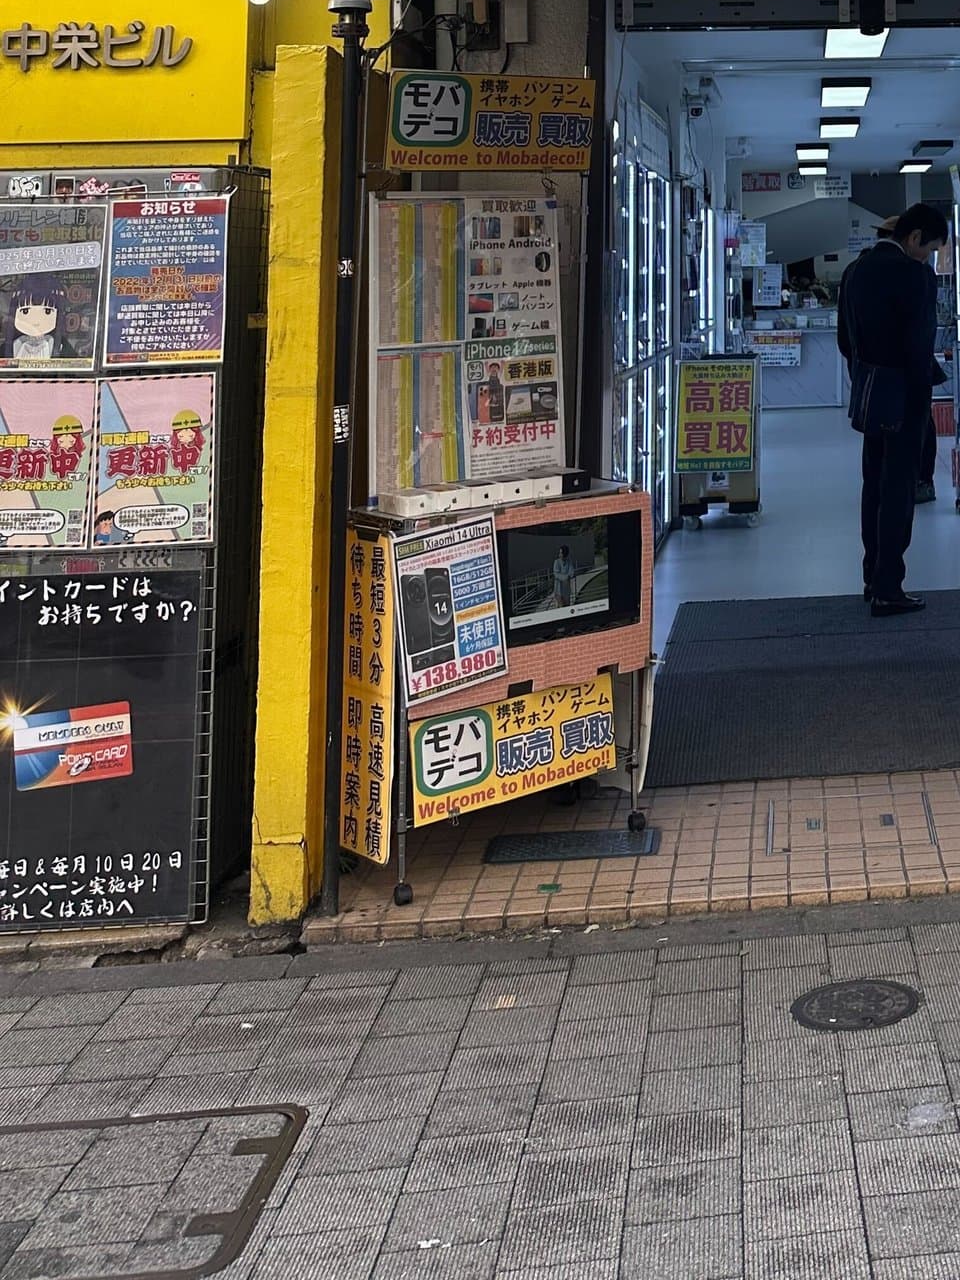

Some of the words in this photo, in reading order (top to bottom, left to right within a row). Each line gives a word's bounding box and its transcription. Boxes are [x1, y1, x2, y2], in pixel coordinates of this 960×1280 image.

[3, 21, 193, 71] 中栄ビル
[404, 83, 461, 107] モバ
[480, 79, 509, 93] 携帯
[524, 81, 579, 94] パソコン
[480, 94, 537, 108] イヤホン
[552, 95, 591, 109] ゲーム
[403, 112, 458, 137] デコ
[474, 111, 532, 147] 販売
[537, 112, 592, 148] 買取
[391, 149, 468, 166] Welcome
[476, 151, 492, 166] to
[497, 150, 585, 166] Mobadeco!!
[140, 201, 196, 215] お知らせ
[470, 240, 506, 250] iPhone
[508, 238, 552, 249] Android
[467, 342, 511, 359] iPhone
[508, 360, 552, 379] 香港版
[685, 380, 751, 413] 高額
[472, 420, 556, 448] 予約受付中
[682, 421, 748, 454] 買取
[106, 444, 201, 479] 更新中
[425, 534, 455, 550] Xiaomi
[457, 529, 467, 540] 14
[469, 525, 490, 537] Ultra
[349, 543, 364, 682] 待ち時間
[369, 546, 386, 688] 最短3分
[435, 600, 448, 616] 14
[460, 620, 496, 644] 未使用
[496, 700, 525, 720] 携帯
[541, 683, 596, 708] パソコン
[498, 709, 555, 733] イヤホン
[571, 693, 610, 714] ゲーム
[425, 717, 481, 753] モバ
[496, 727, 553, 777] 販売
[561, 711, 614, 757] 買取
[344, 696, 362, 849] 即時案内
[364, 703, 385, 857] 高速見積
[418, 787, 496, 820] Welcome
[501, 780, 518, 796] to
[522, 750, 611, 791] Mobadeco!!
[427, 752, 482, 787] デコ
[0, 899, 134, 921] 詳しくは店内へ
